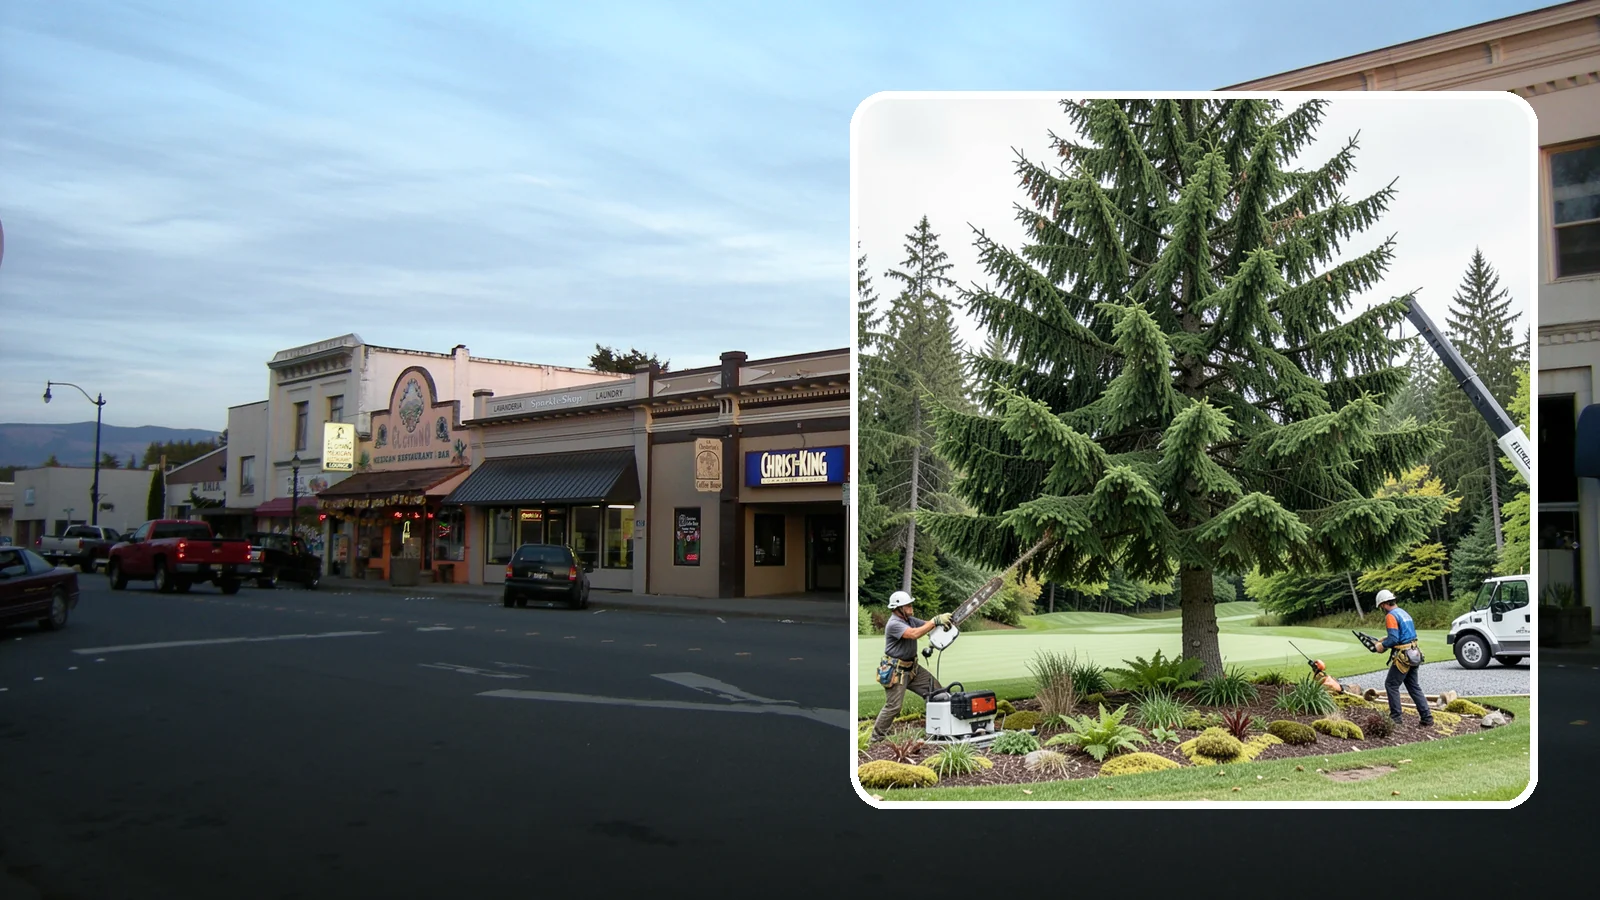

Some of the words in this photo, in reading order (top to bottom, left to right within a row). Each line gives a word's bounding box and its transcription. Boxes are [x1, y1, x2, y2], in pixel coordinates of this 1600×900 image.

[562, 394, 582, 405] Shop
[595, 388, 624, 400] LAUNDRY
[493, 402, 523, 413] LAVANDERIA
[373, 454, 396, 464] MEXICAN
[397, 451, 434, 462] RESTAURANT
[437, 450, 450, 459] BAR
